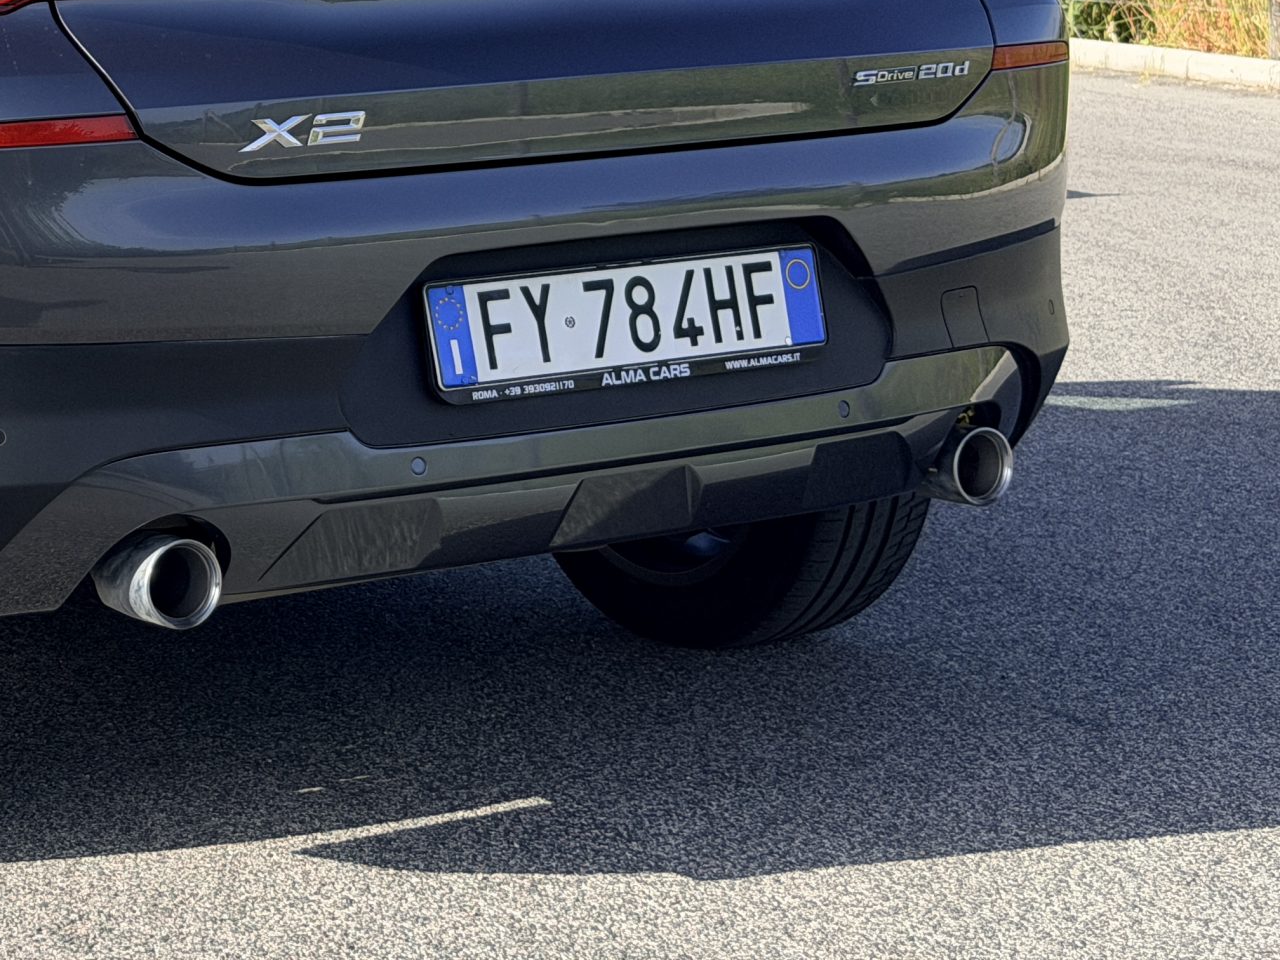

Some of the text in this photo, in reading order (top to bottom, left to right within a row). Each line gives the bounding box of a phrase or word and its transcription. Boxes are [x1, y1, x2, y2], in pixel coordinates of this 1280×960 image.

[919, 60, 970, 79] 20d
[238, 110, 367, 153] X2
[725, 352, 801, 370] WWW.ALMACARS.IT
[601, 363, 691, 387] ALMA CARS
[472, 388, 499, 400] ROMA
[504, 386, 521, 396] +39
